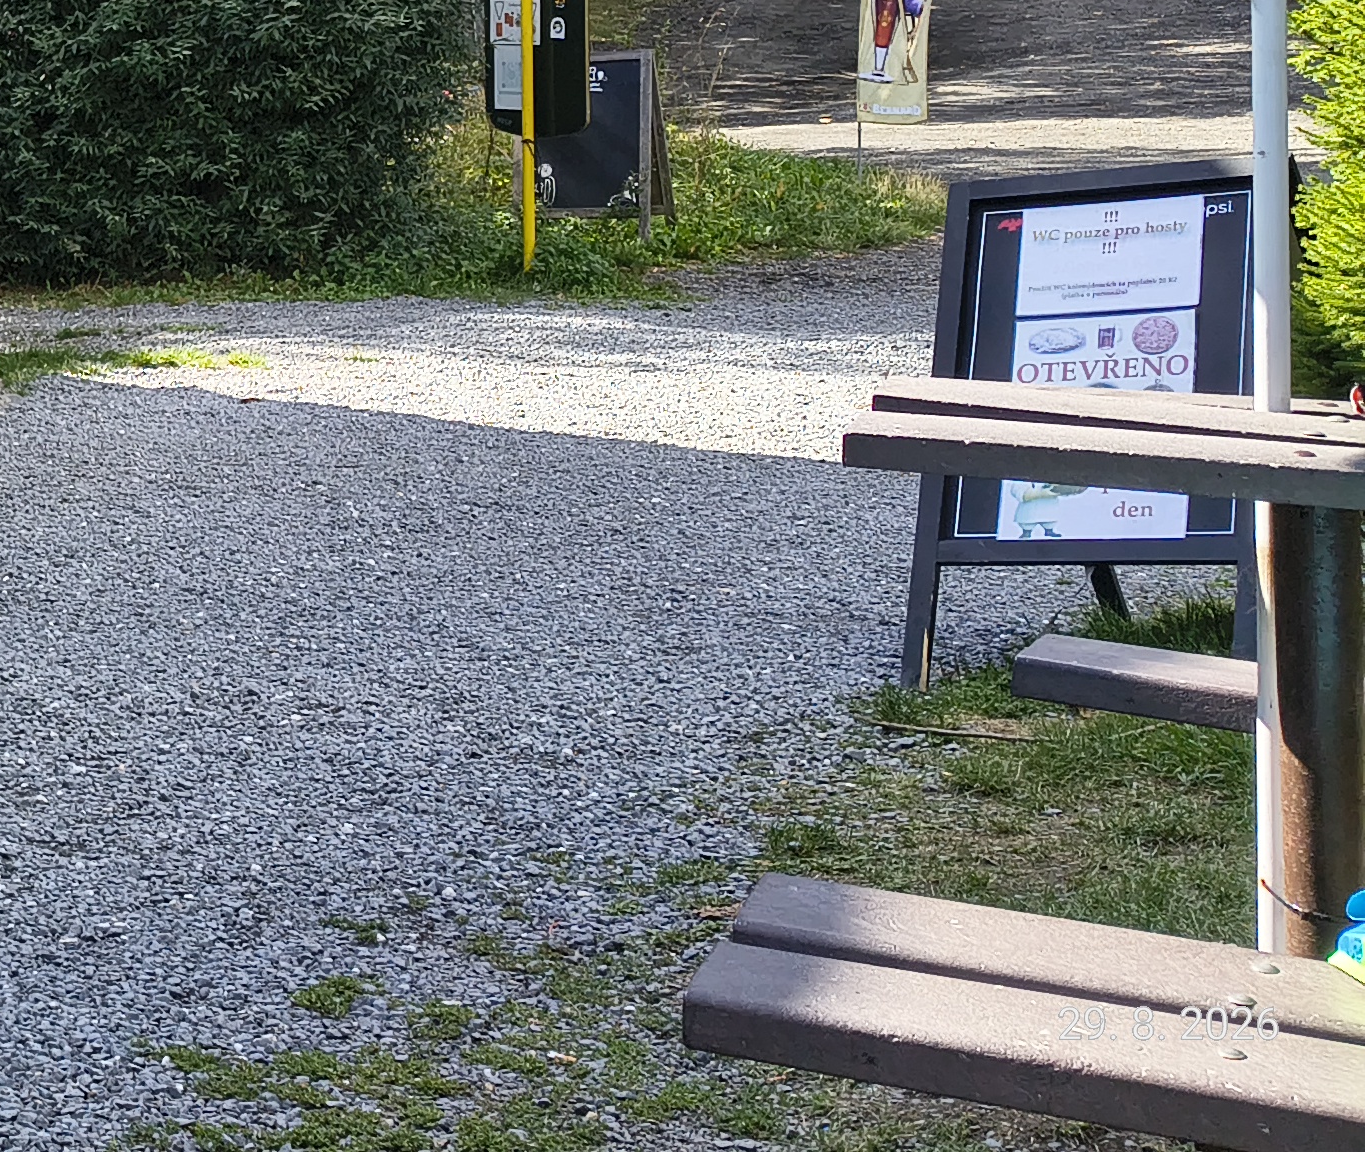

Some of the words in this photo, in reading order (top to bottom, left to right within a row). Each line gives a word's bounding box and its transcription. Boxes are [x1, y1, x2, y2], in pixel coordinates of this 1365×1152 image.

[1205, 200, 1232, 217] psi
[1032, 228, 1061, 242] WC
[1063, 226, 1110, 244] pouze
[1114, 225, 1141, 240] pro
[1144, 220, 1188, 236] hosty
[1017, 353, 1189, 384] OTEVŘENO
[1112, 500, 1153, 518] den
